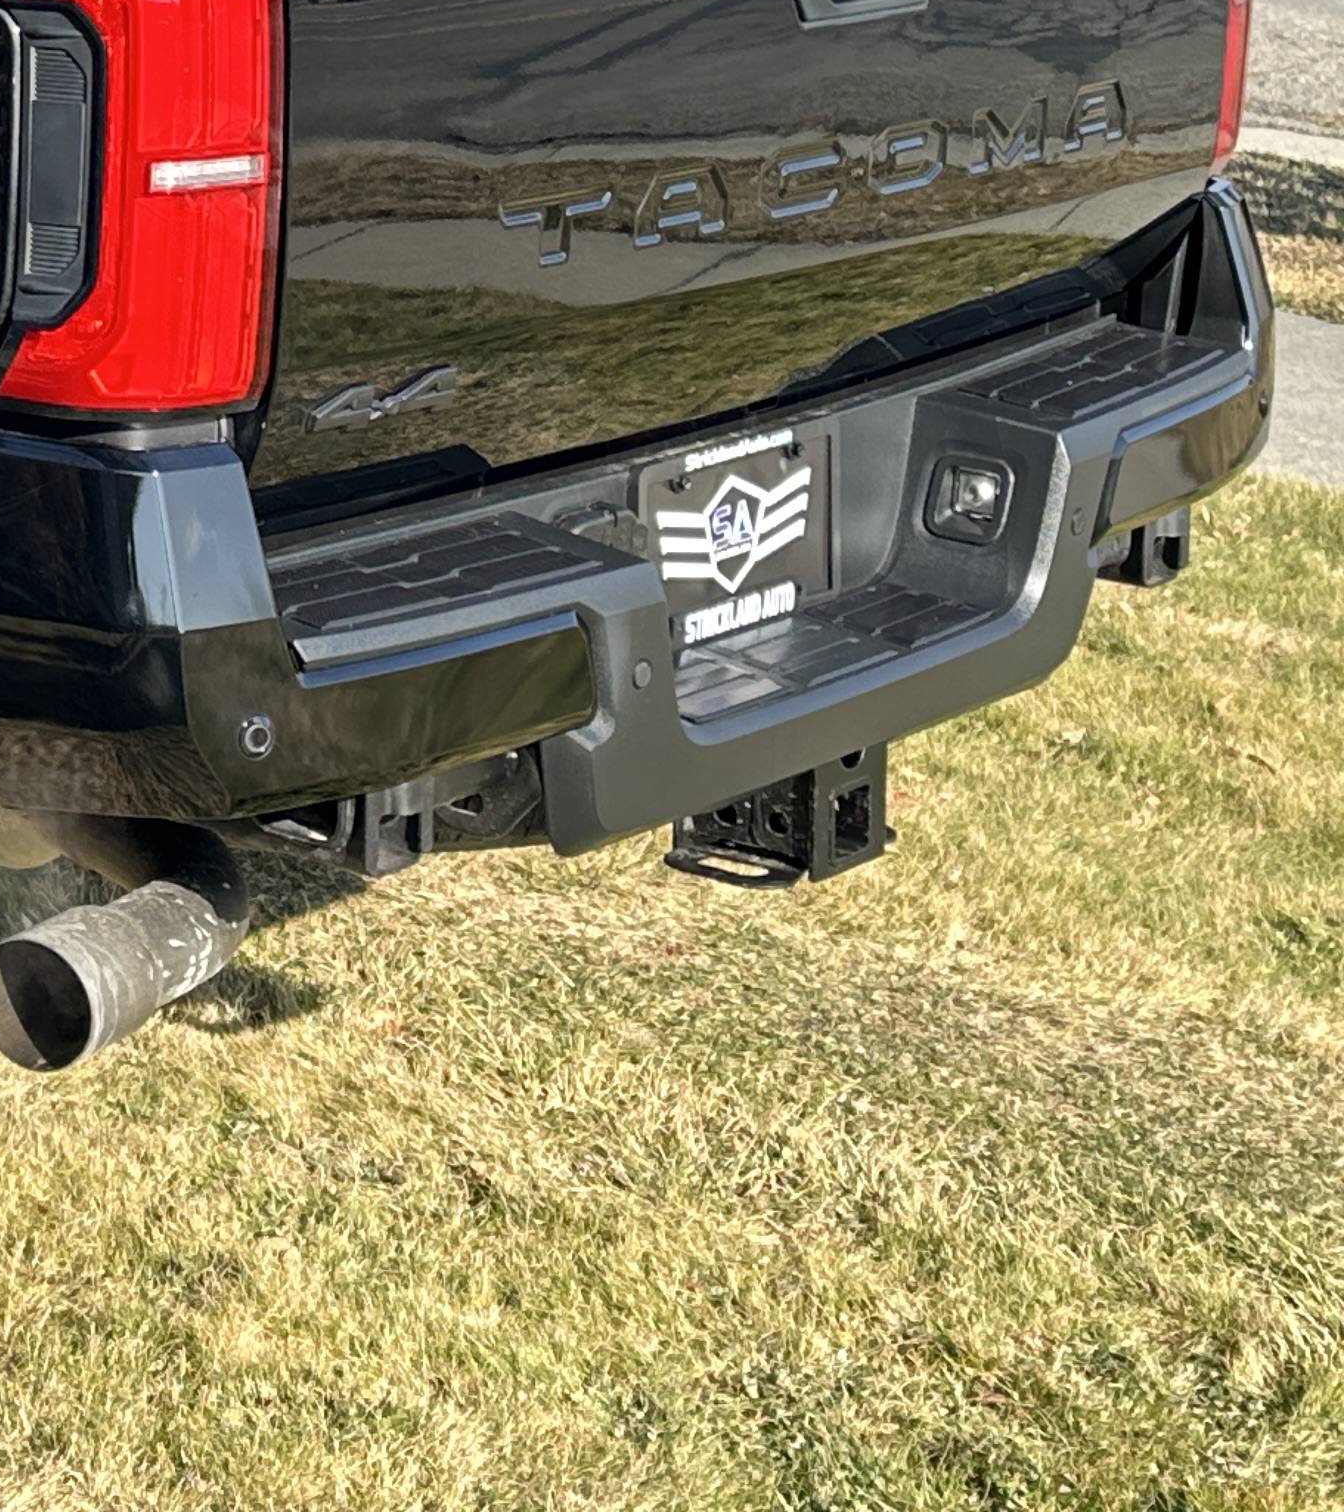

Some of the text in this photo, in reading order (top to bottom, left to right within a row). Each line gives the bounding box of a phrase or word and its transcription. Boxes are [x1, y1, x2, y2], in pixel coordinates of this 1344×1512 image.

[498, 78, 1133, 268] TACOMA
[712, 498, 754, 550] SA
[684, 580, 796, 644] STRICKLAND AUTO
